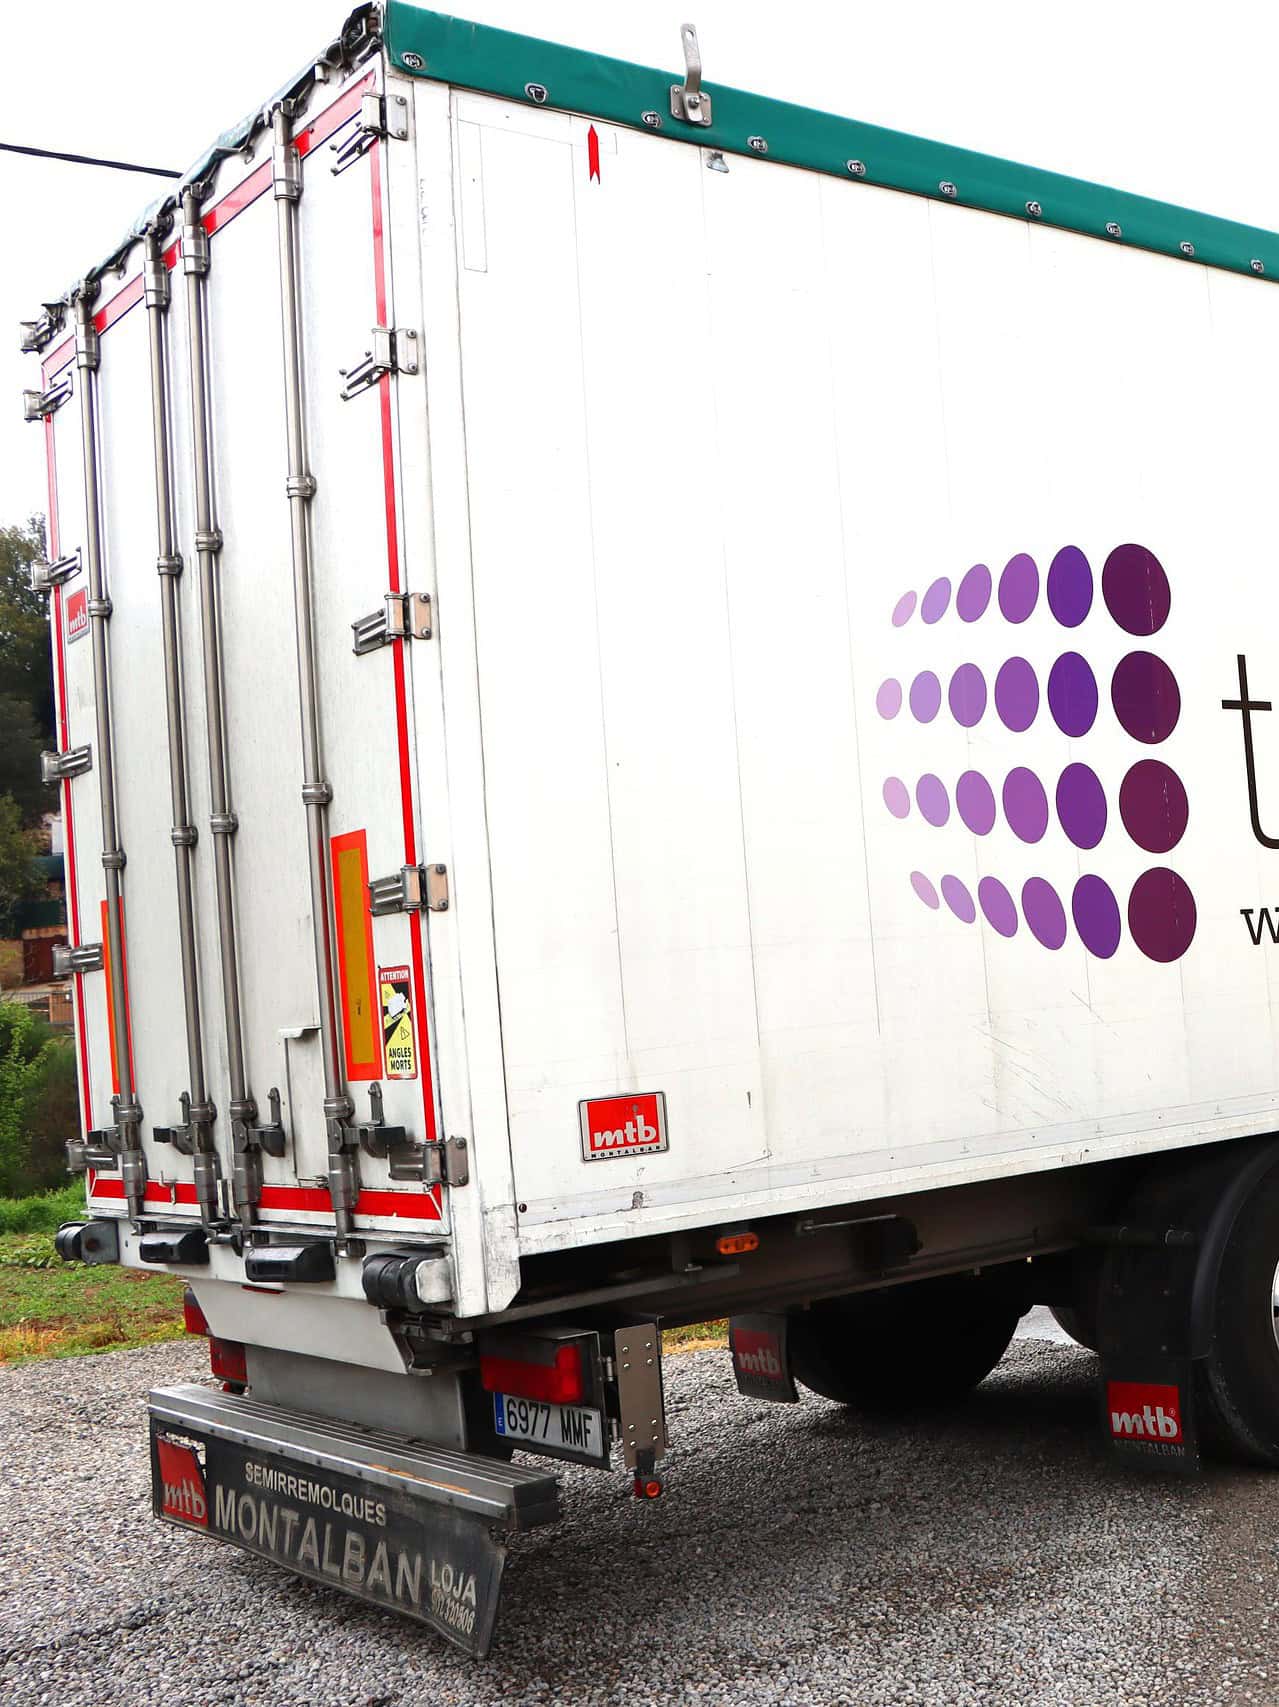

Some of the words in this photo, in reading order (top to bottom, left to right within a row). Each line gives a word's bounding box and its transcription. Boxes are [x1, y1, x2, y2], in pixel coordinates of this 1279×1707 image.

[69, 605, 87, 633] mtb
[388, 1047, 412, 1058] ANGLES
[390, 1059, 412, 1071] MORTS
[593, 1114, 657, 1148] mtb
[738, 1347, 780, 1375] mtb
[507, 1398, 551, 1439] 6977
[560, 1407, 593, 1448] MMF
[1111, 1405, 1178, 1438] mtb
[163, 1479, 206, 1519] mtb
[245, 1461, 387, 1527] SEMIRREMOLQUES
[214, 1484, 422, 1604] MONTALBAN
[431, 1559, 477, 1607] LOJA
